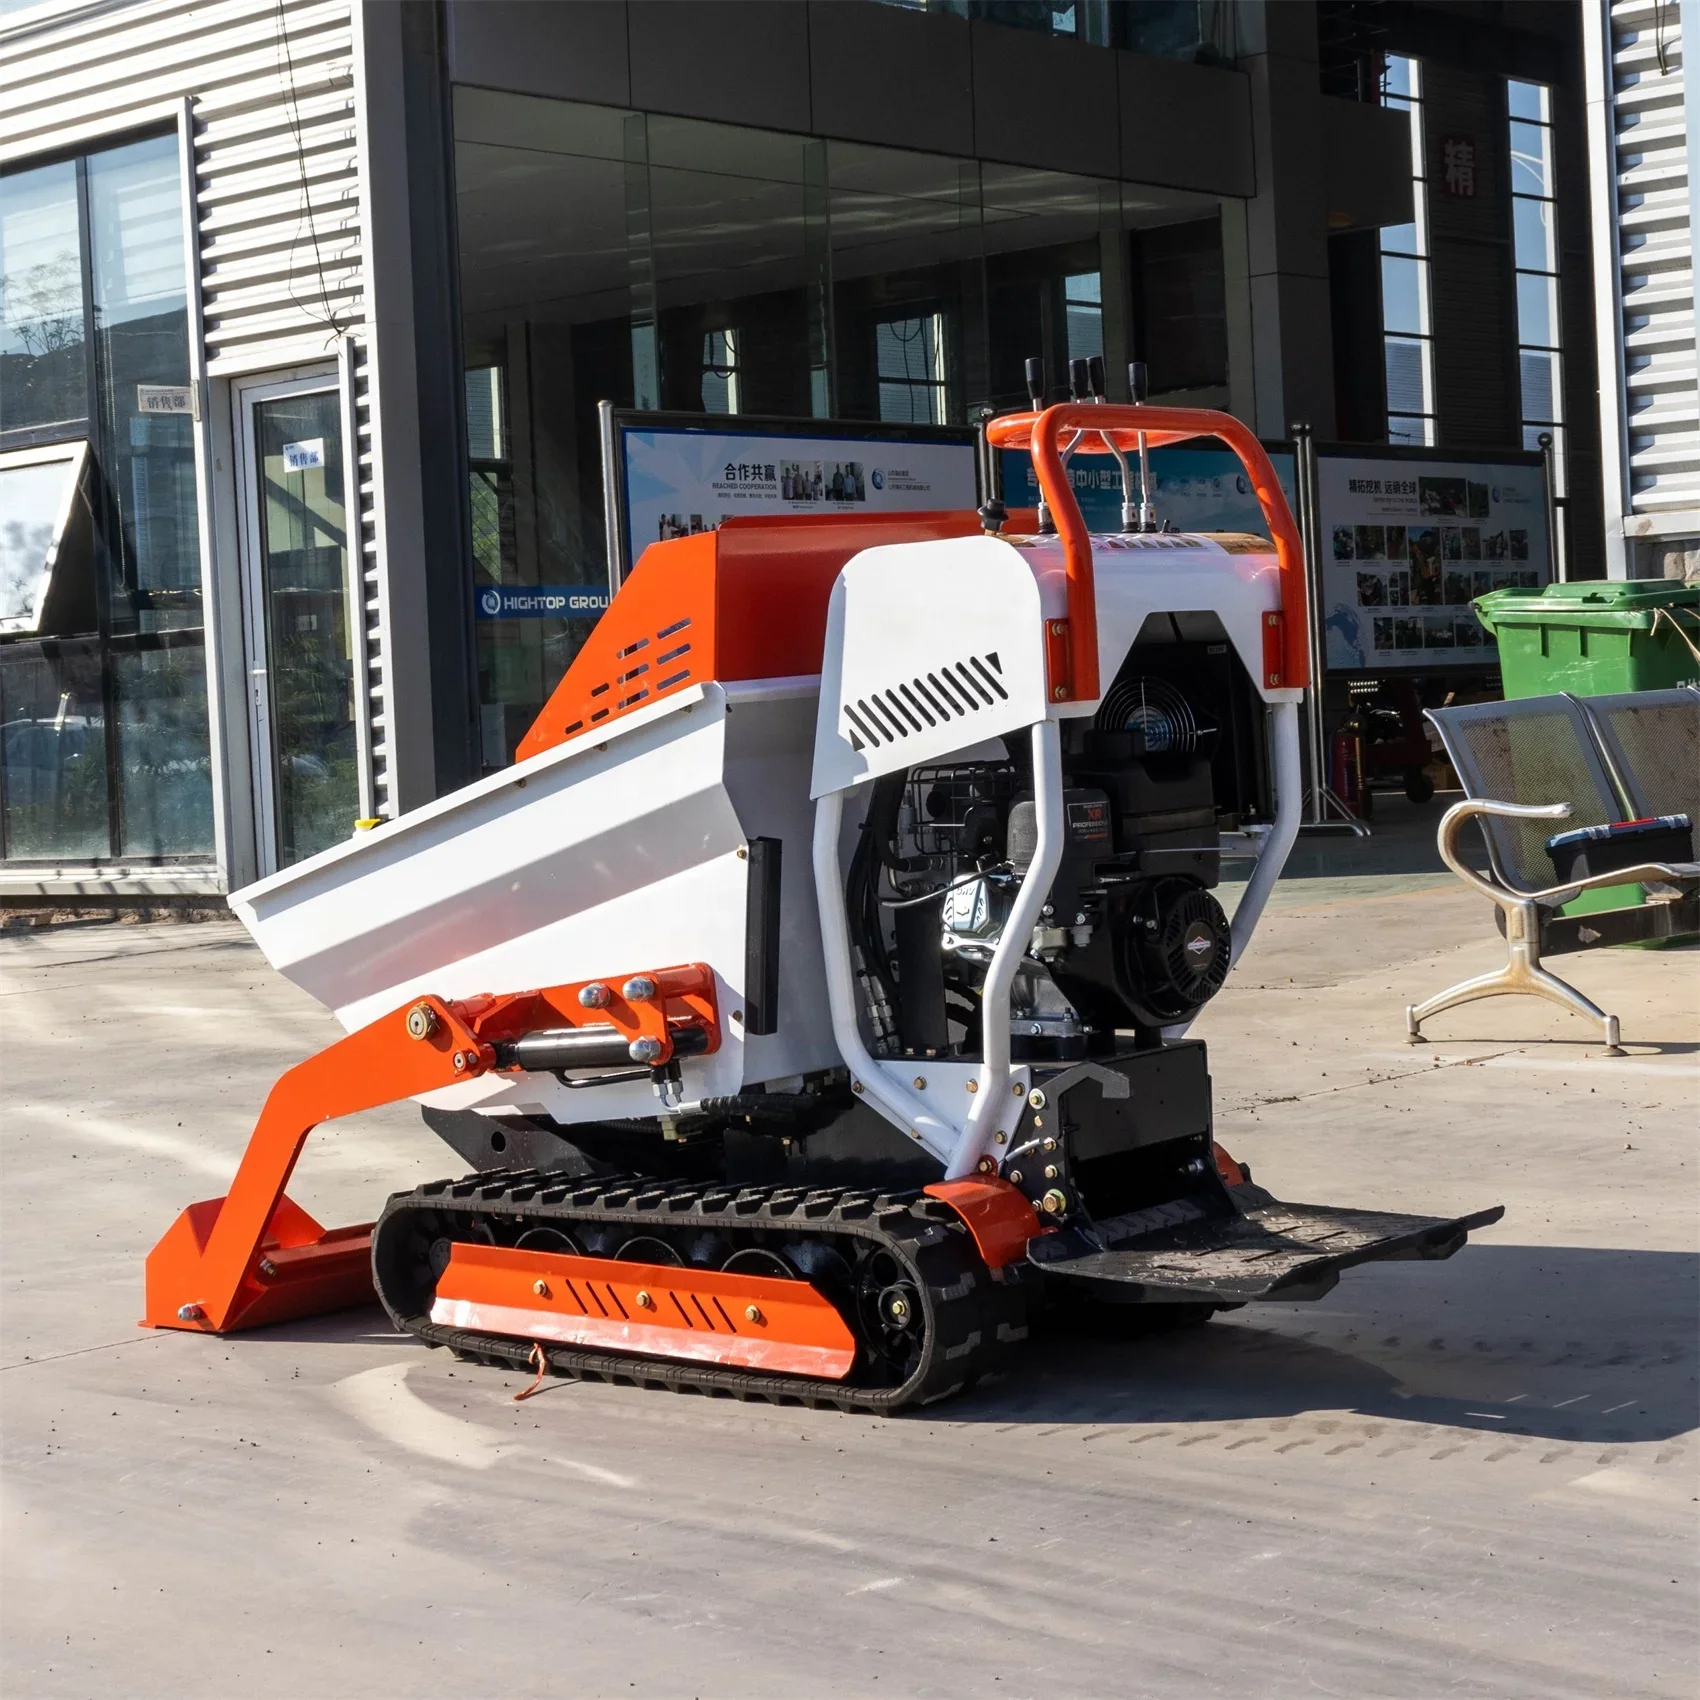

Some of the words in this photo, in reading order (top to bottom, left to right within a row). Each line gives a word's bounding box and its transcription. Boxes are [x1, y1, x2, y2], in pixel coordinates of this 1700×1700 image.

[1444, 138, 1474, 197] 精
[723, 462, 777, 482] 合作共赢
[711, 482, 738, 490] REACHED
[739, 483, 777, 491] COOPERATION
[503, 595, 565, 610] HIGHTOP
[569, 595, 609, 609] GROU
